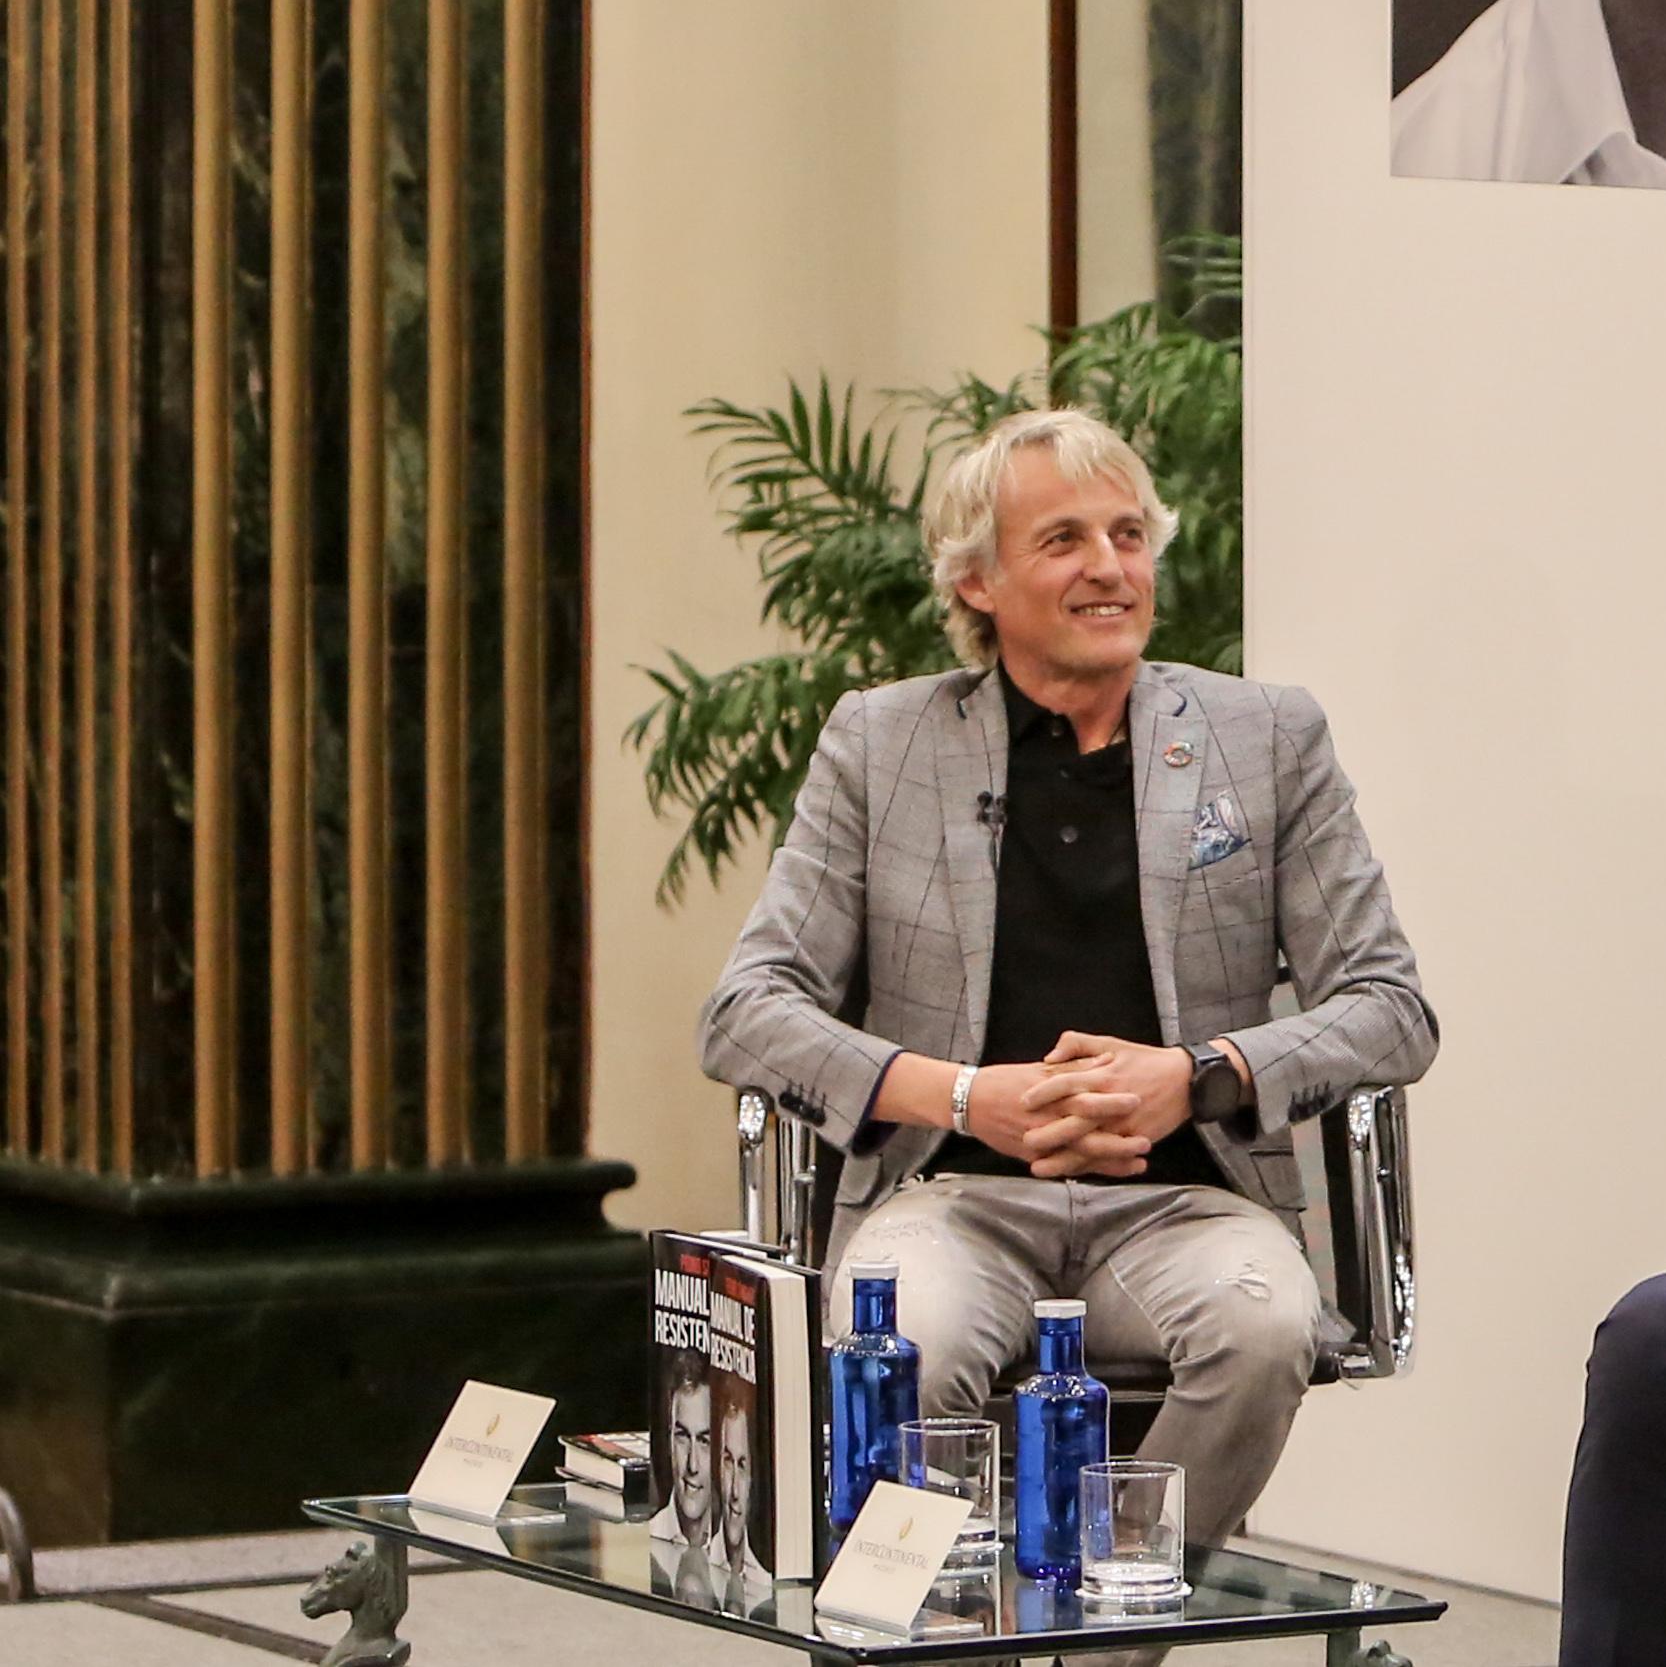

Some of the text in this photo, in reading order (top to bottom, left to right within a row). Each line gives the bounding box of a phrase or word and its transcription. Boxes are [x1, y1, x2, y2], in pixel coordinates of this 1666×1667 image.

[654, 1268, 711, 1317] MANUAL
[654, 1309, 711, 1355] RESISTEN
[743, 1304, 756, 1346] DE
